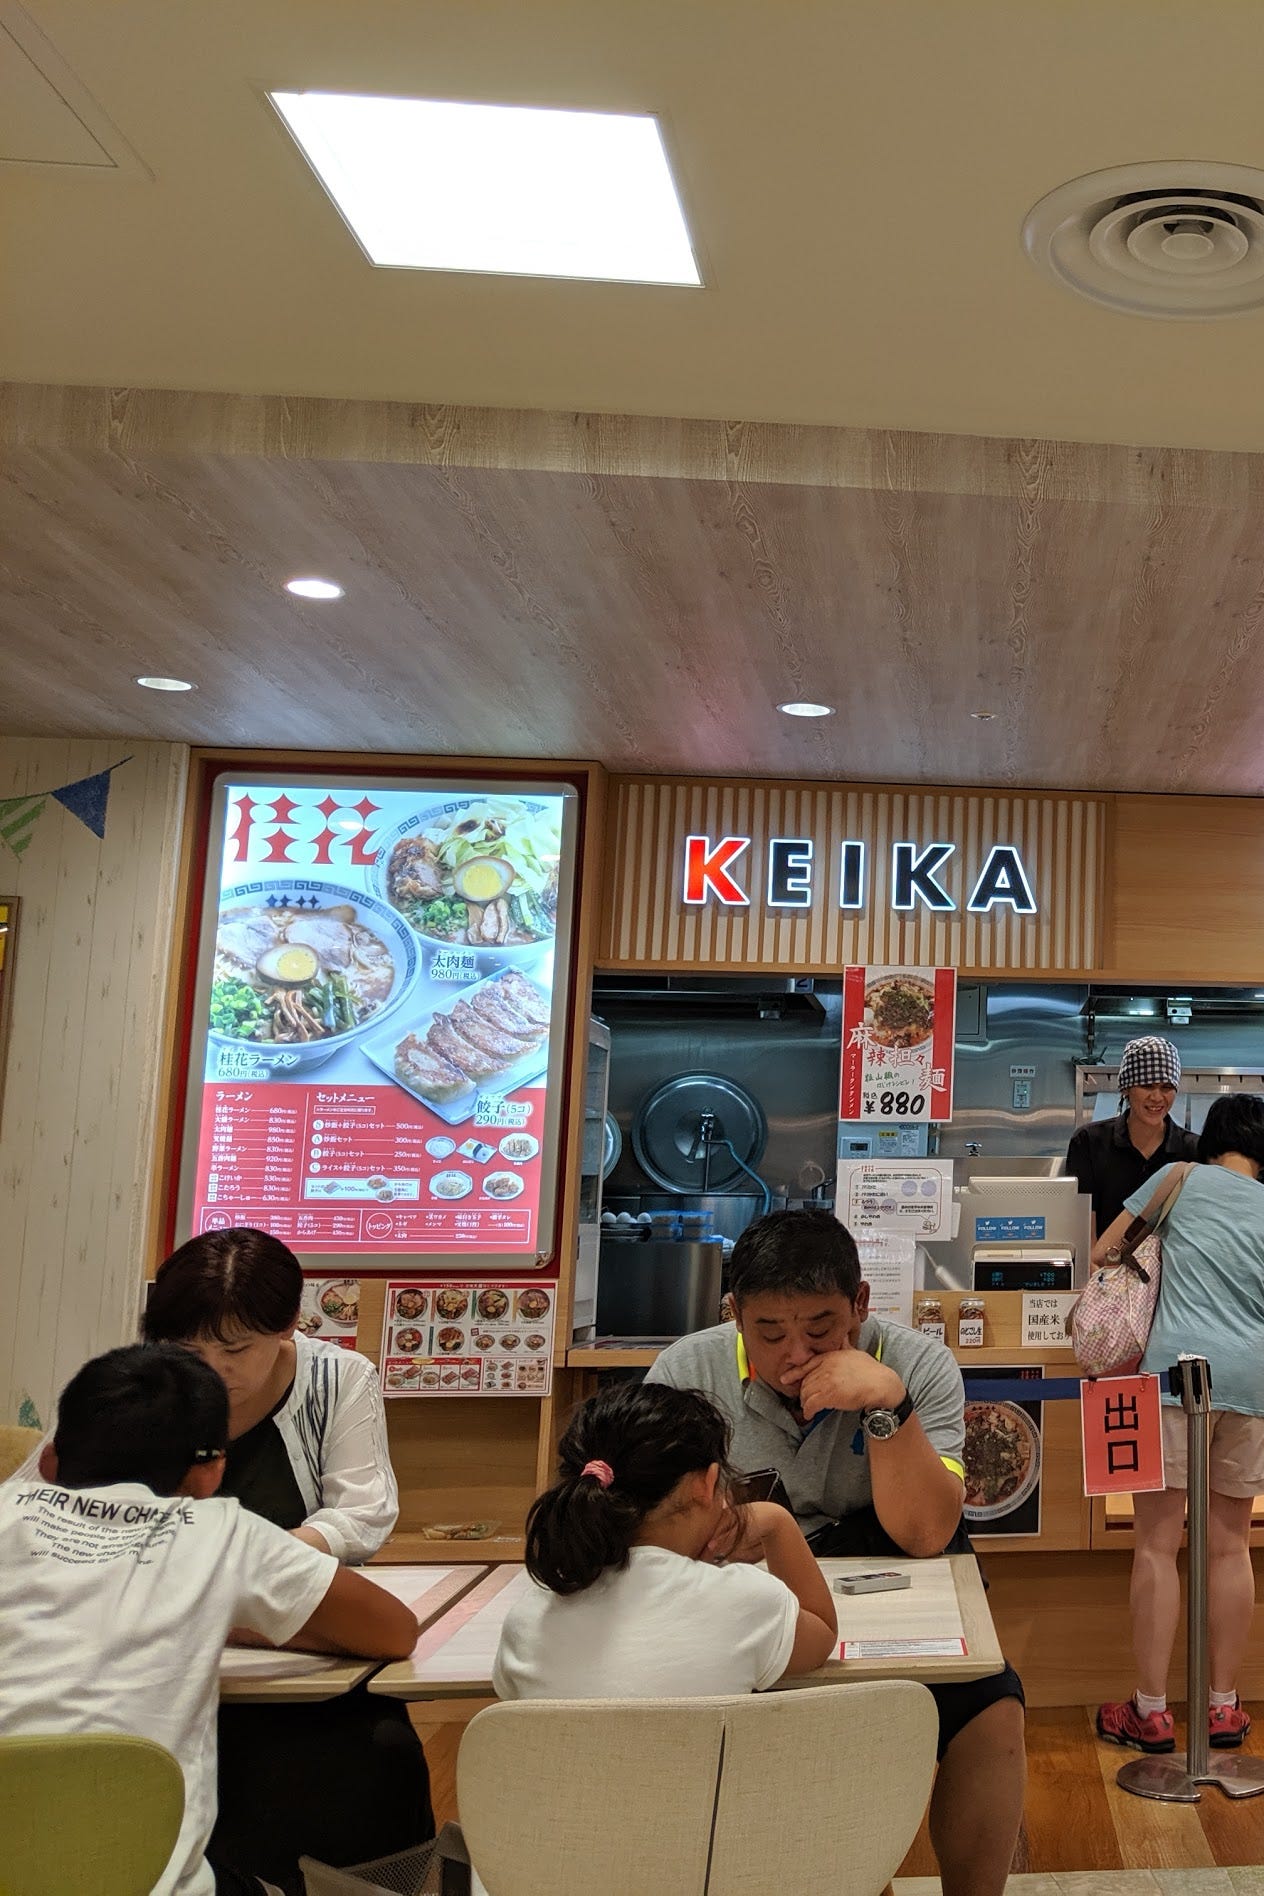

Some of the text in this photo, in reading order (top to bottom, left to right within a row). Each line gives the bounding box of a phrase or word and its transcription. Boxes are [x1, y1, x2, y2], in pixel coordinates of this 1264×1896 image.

[683, 835, 1037, 914] KEIKA
[432, 955, 475, 969] 太肉麺
[220, 1052, 298, 1066] 桂花ラーメン
[216, 1091, 253, 1101] ラーメン
[316, 1091, 376, 1103] セットメニュー
[1029, 1299, 1058, 1309] 当店では
[1028, 1314, 1067, 1326] 国産米
[922, 1327, 944, 1336] ビール
[1104, 1393, 1139, 1475] 出口
[16, 1489, 70, 1511] THEIR
[71, 1496, 122, 1520] NEW
[38, 1506, 55, 1518] The
[57, 1516, 86, 1529] result
[40, 1520, 69, 1533] make
[35, 1528, 59, 1541] They
[81, 1540, 100, 1549] not
